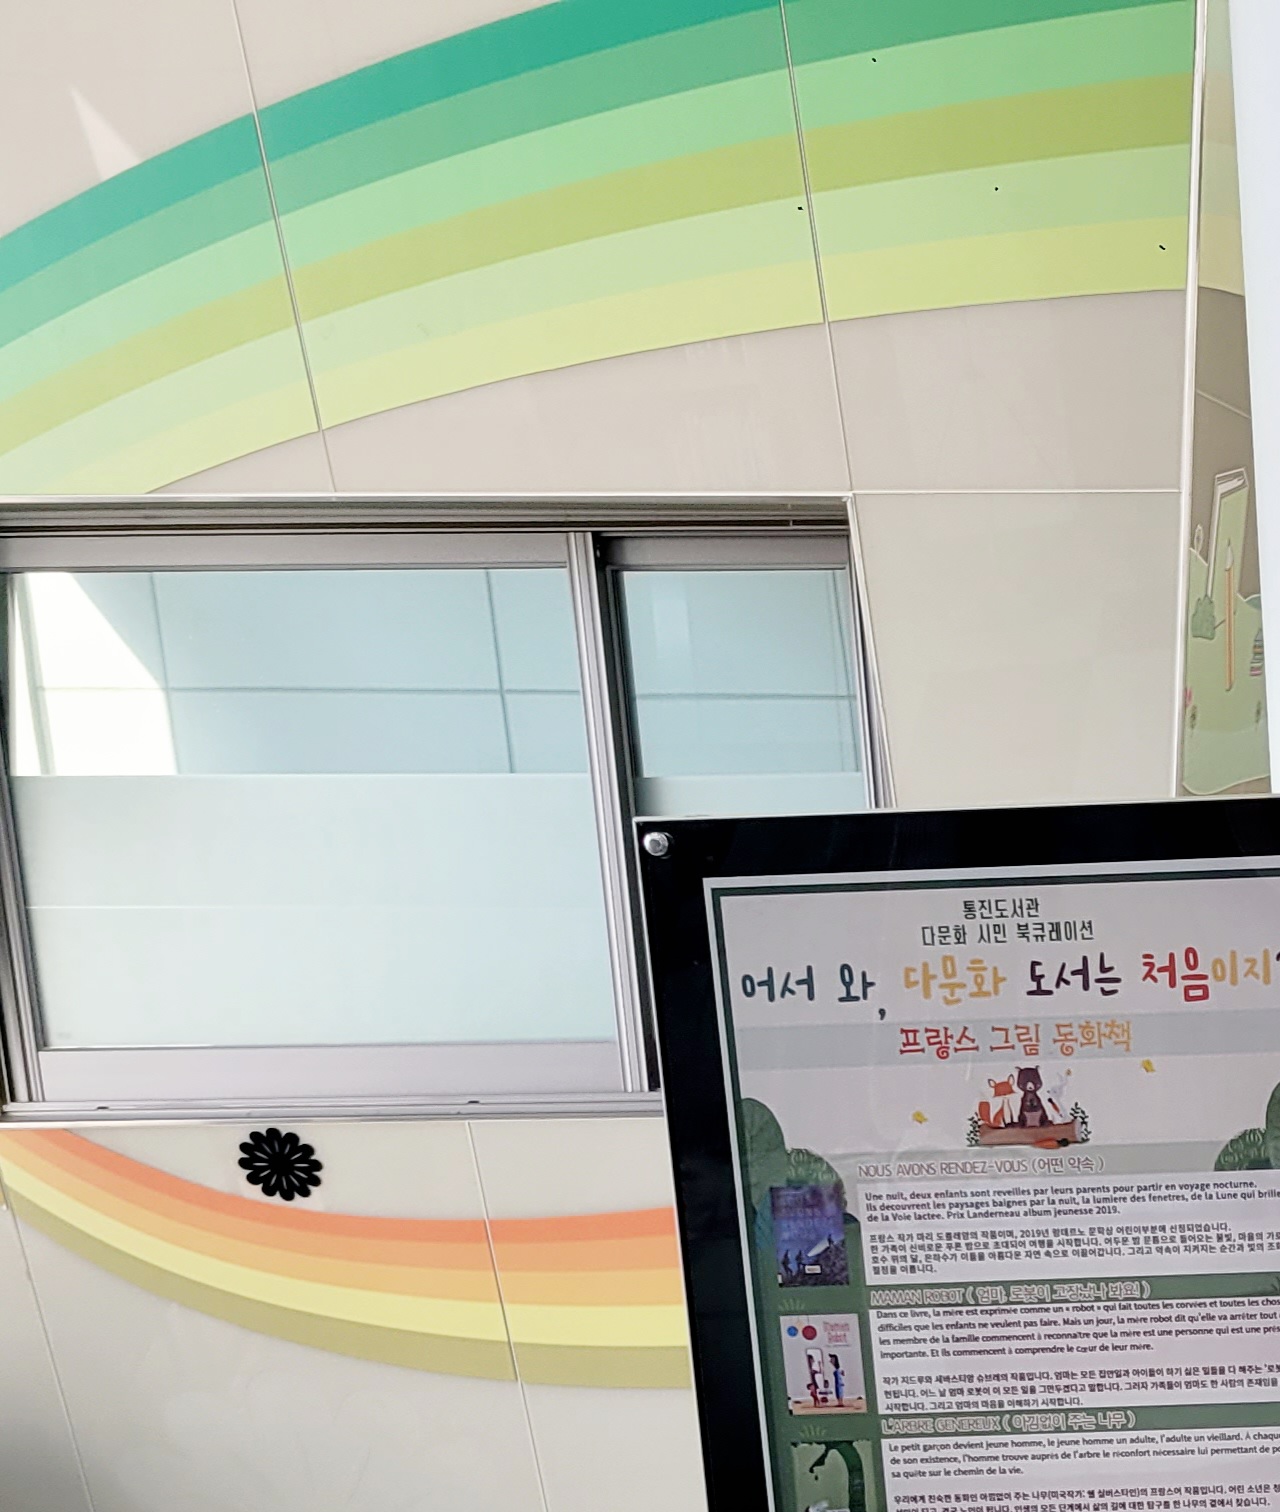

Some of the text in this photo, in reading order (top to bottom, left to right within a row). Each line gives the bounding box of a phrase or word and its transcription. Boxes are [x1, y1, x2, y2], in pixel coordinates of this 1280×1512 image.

[962, 898, 1040, 919] 통진도서관
[921, 919, 1095, 946] 다문화 시민 북큐레이션
[741, 966, 816, 1002] 어서
[838, 963, 887, 1021] 와,
[903, 955, 1007, 1005] 다문화
[1026, 951, 1123, 997] 도서는
[900, 1019, 1132, 1057] 프랑스 그림 동화책
[859, 1164, 891, 1177] NOUS
[897, 1163, 936, 1176] AVONS
[941, 1160, 1028, 1175] RENDEZ-VOUS
[1068, 1157, 1094, 1172] 약속
[865, 1192, 883, 1201] Une
[910, 1190, 932, 1199] deux
[934, 1188, 968, 1199] enfants
[970, 1189, 991, 1197] sont
[1033, 1188, 1049, 1198] par
[1051, 1186, 1073, 1195] leurs
[1076, 1185, 1110, 1195] parents
[1113, 1184, 1134, 1194] pour
[1137, 1182, 1162, 1193] partir
[1165, 1183, 1176, 1191] en
[1179, 1182, 1210, 1192] voyage
[1213, 1180, 1257, 1189] nocturne.
[871, 1289, 922, 1305] MAMAN
[924, 1288, 964, 1304] ROBOT
[881, 1418, 934, 1435] L'ARBRE
[935, 1416, 1000, 1433] GENEREUX
[889, 1443, 899, 1451] Le
[901, 1442, 920, 1453] petit
[953, 1441, 983, 1450] devient
[985, 1440, 1009, 1450] jeune
[1011, 1439, 1045, 1449] homme,
[1047, 1438, 1054, 1446] le
[1057, 1438, 1080, 1448] jeune
[1082, 1437, 1114, 1446] homme
